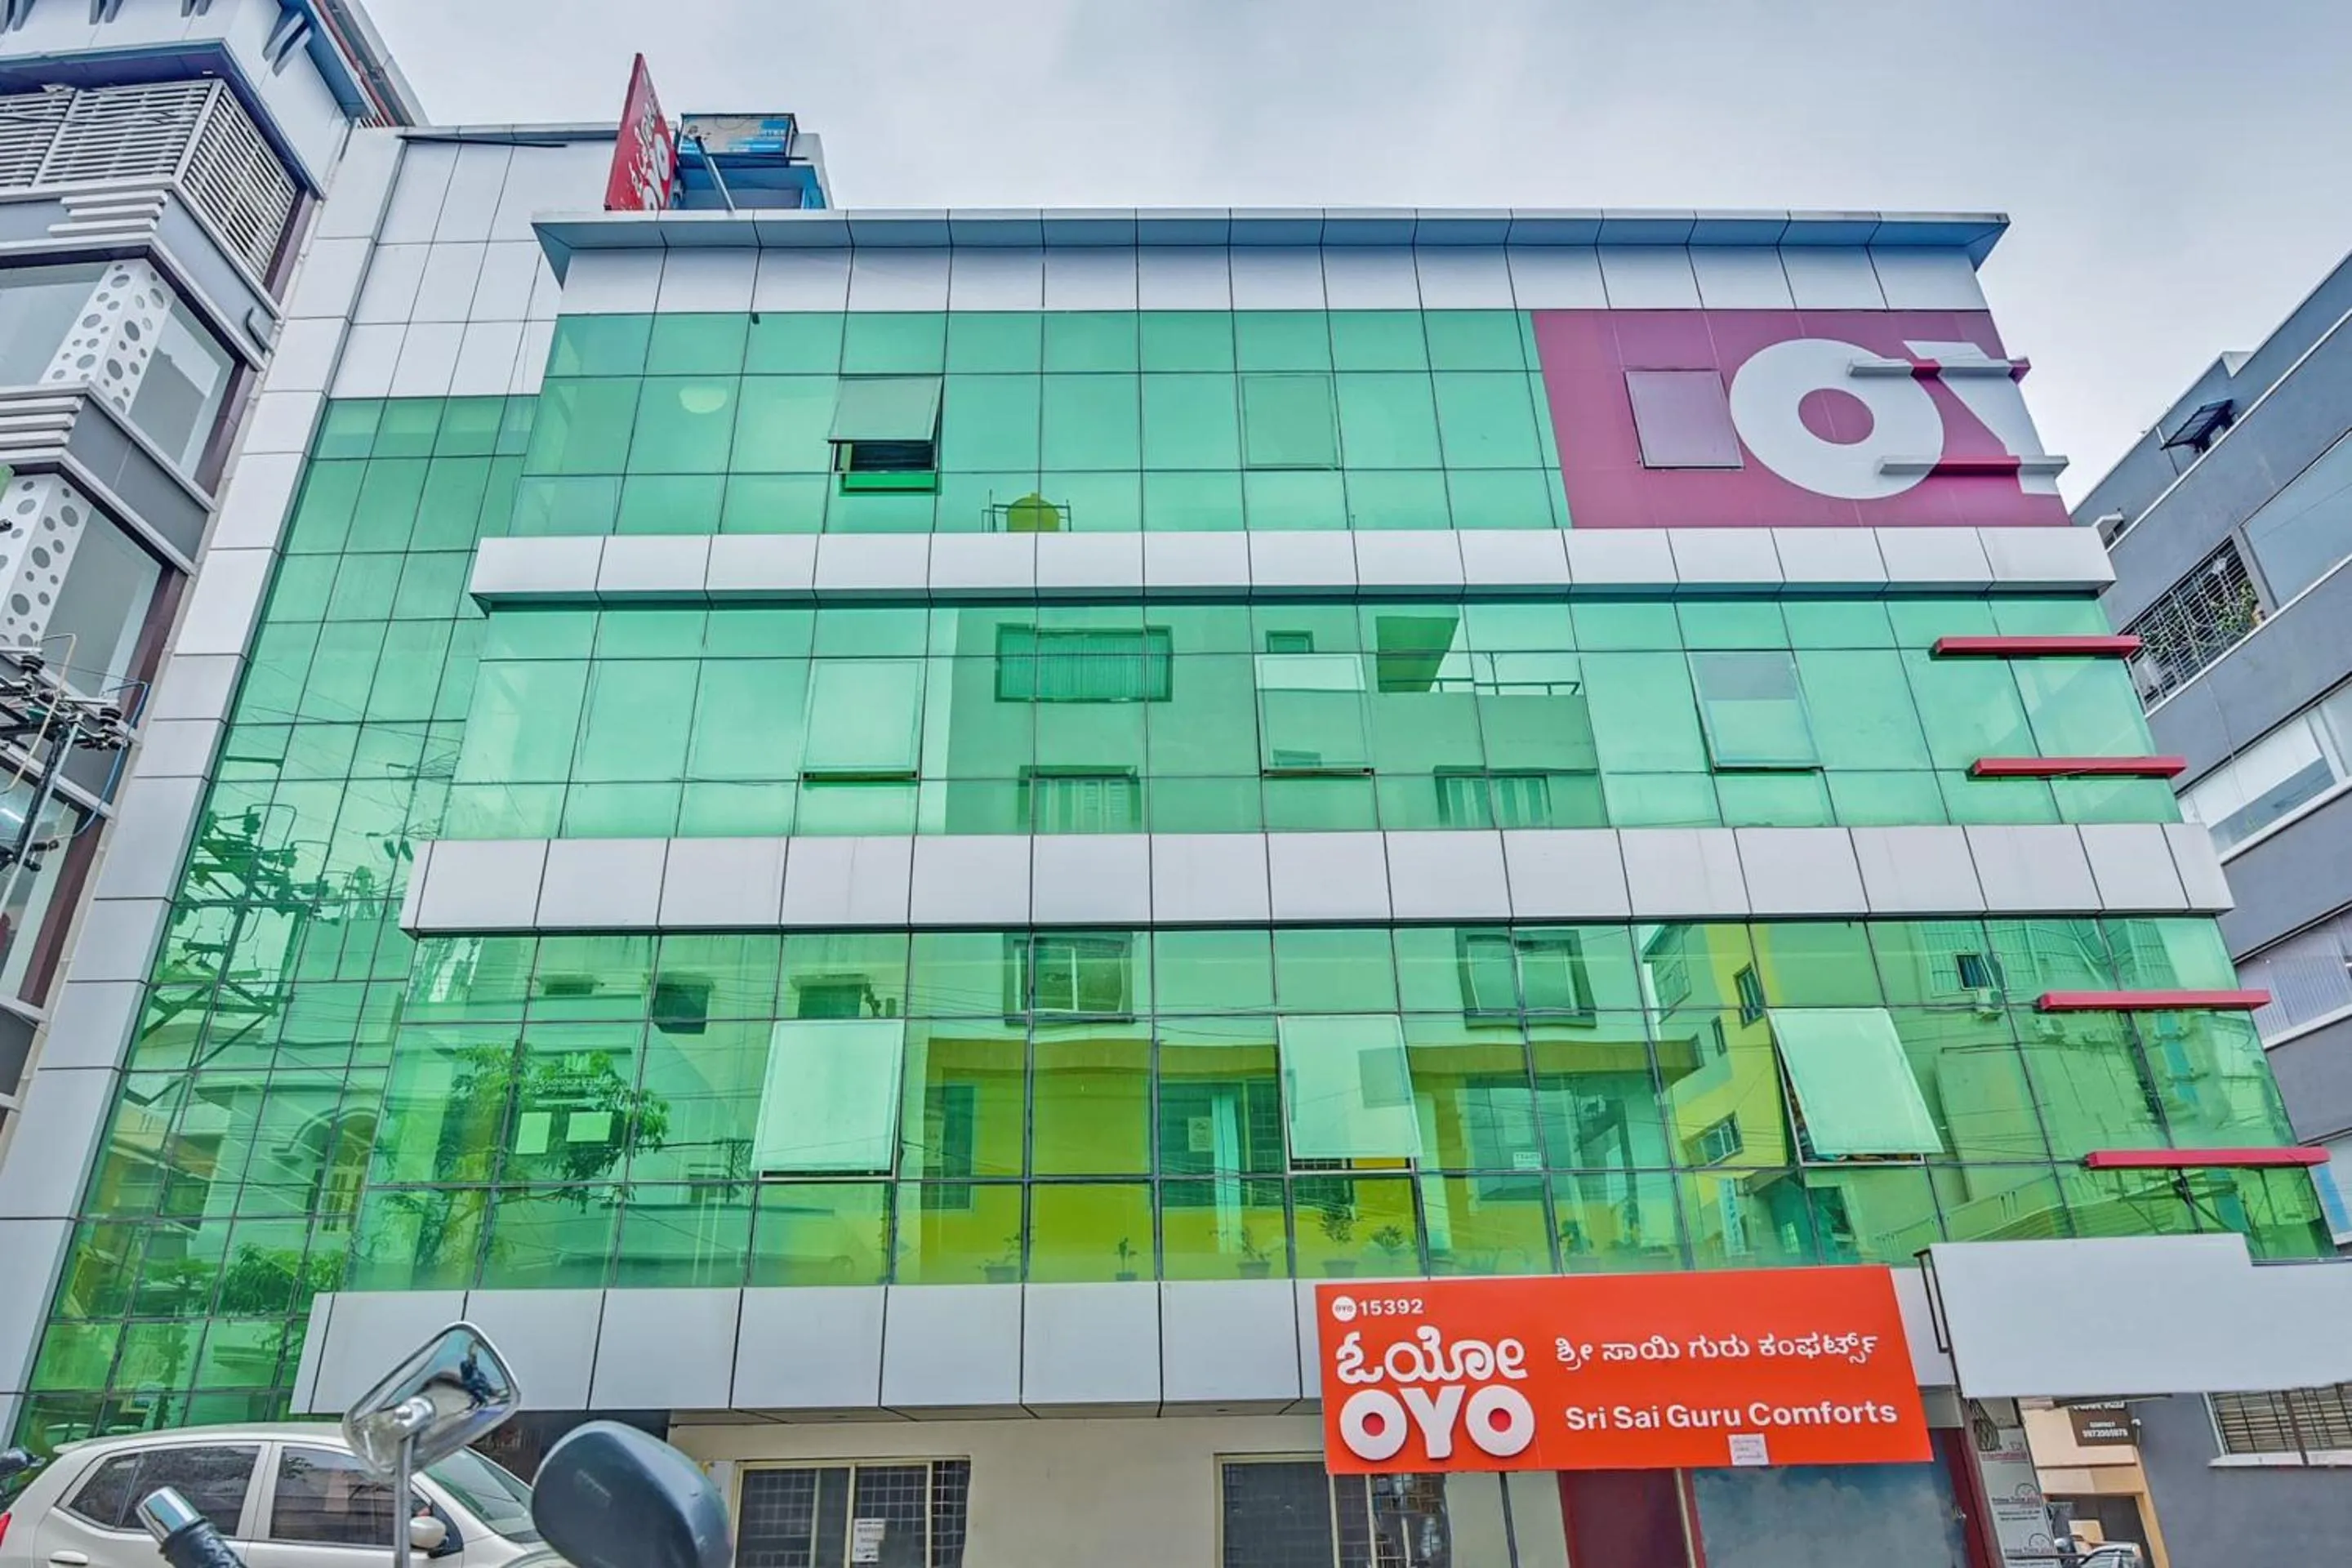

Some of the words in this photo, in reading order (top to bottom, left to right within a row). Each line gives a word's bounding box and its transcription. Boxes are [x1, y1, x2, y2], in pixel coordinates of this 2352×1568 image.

[1360, 1298, 1423, 1316] 15392
[1335, 1325, 1528, 1384] ಓಯೋ
[1555, 1337, 1593, 1370] ಶ್ರೀ
[1601, 1334, 1680, 1361] ಸಾಯಿ
[1688, 1334, 1750, 1358] ಗುರು
[1339, 1384, 1535, 1460] OYO
[1566, 1406, 1606, 1430] Sri
[1613, 1405, 1660, 1429] Sai
[1667, 1404, 1741, 1428] Guru
[1748, 1401, 1898, 1426] Comforts
